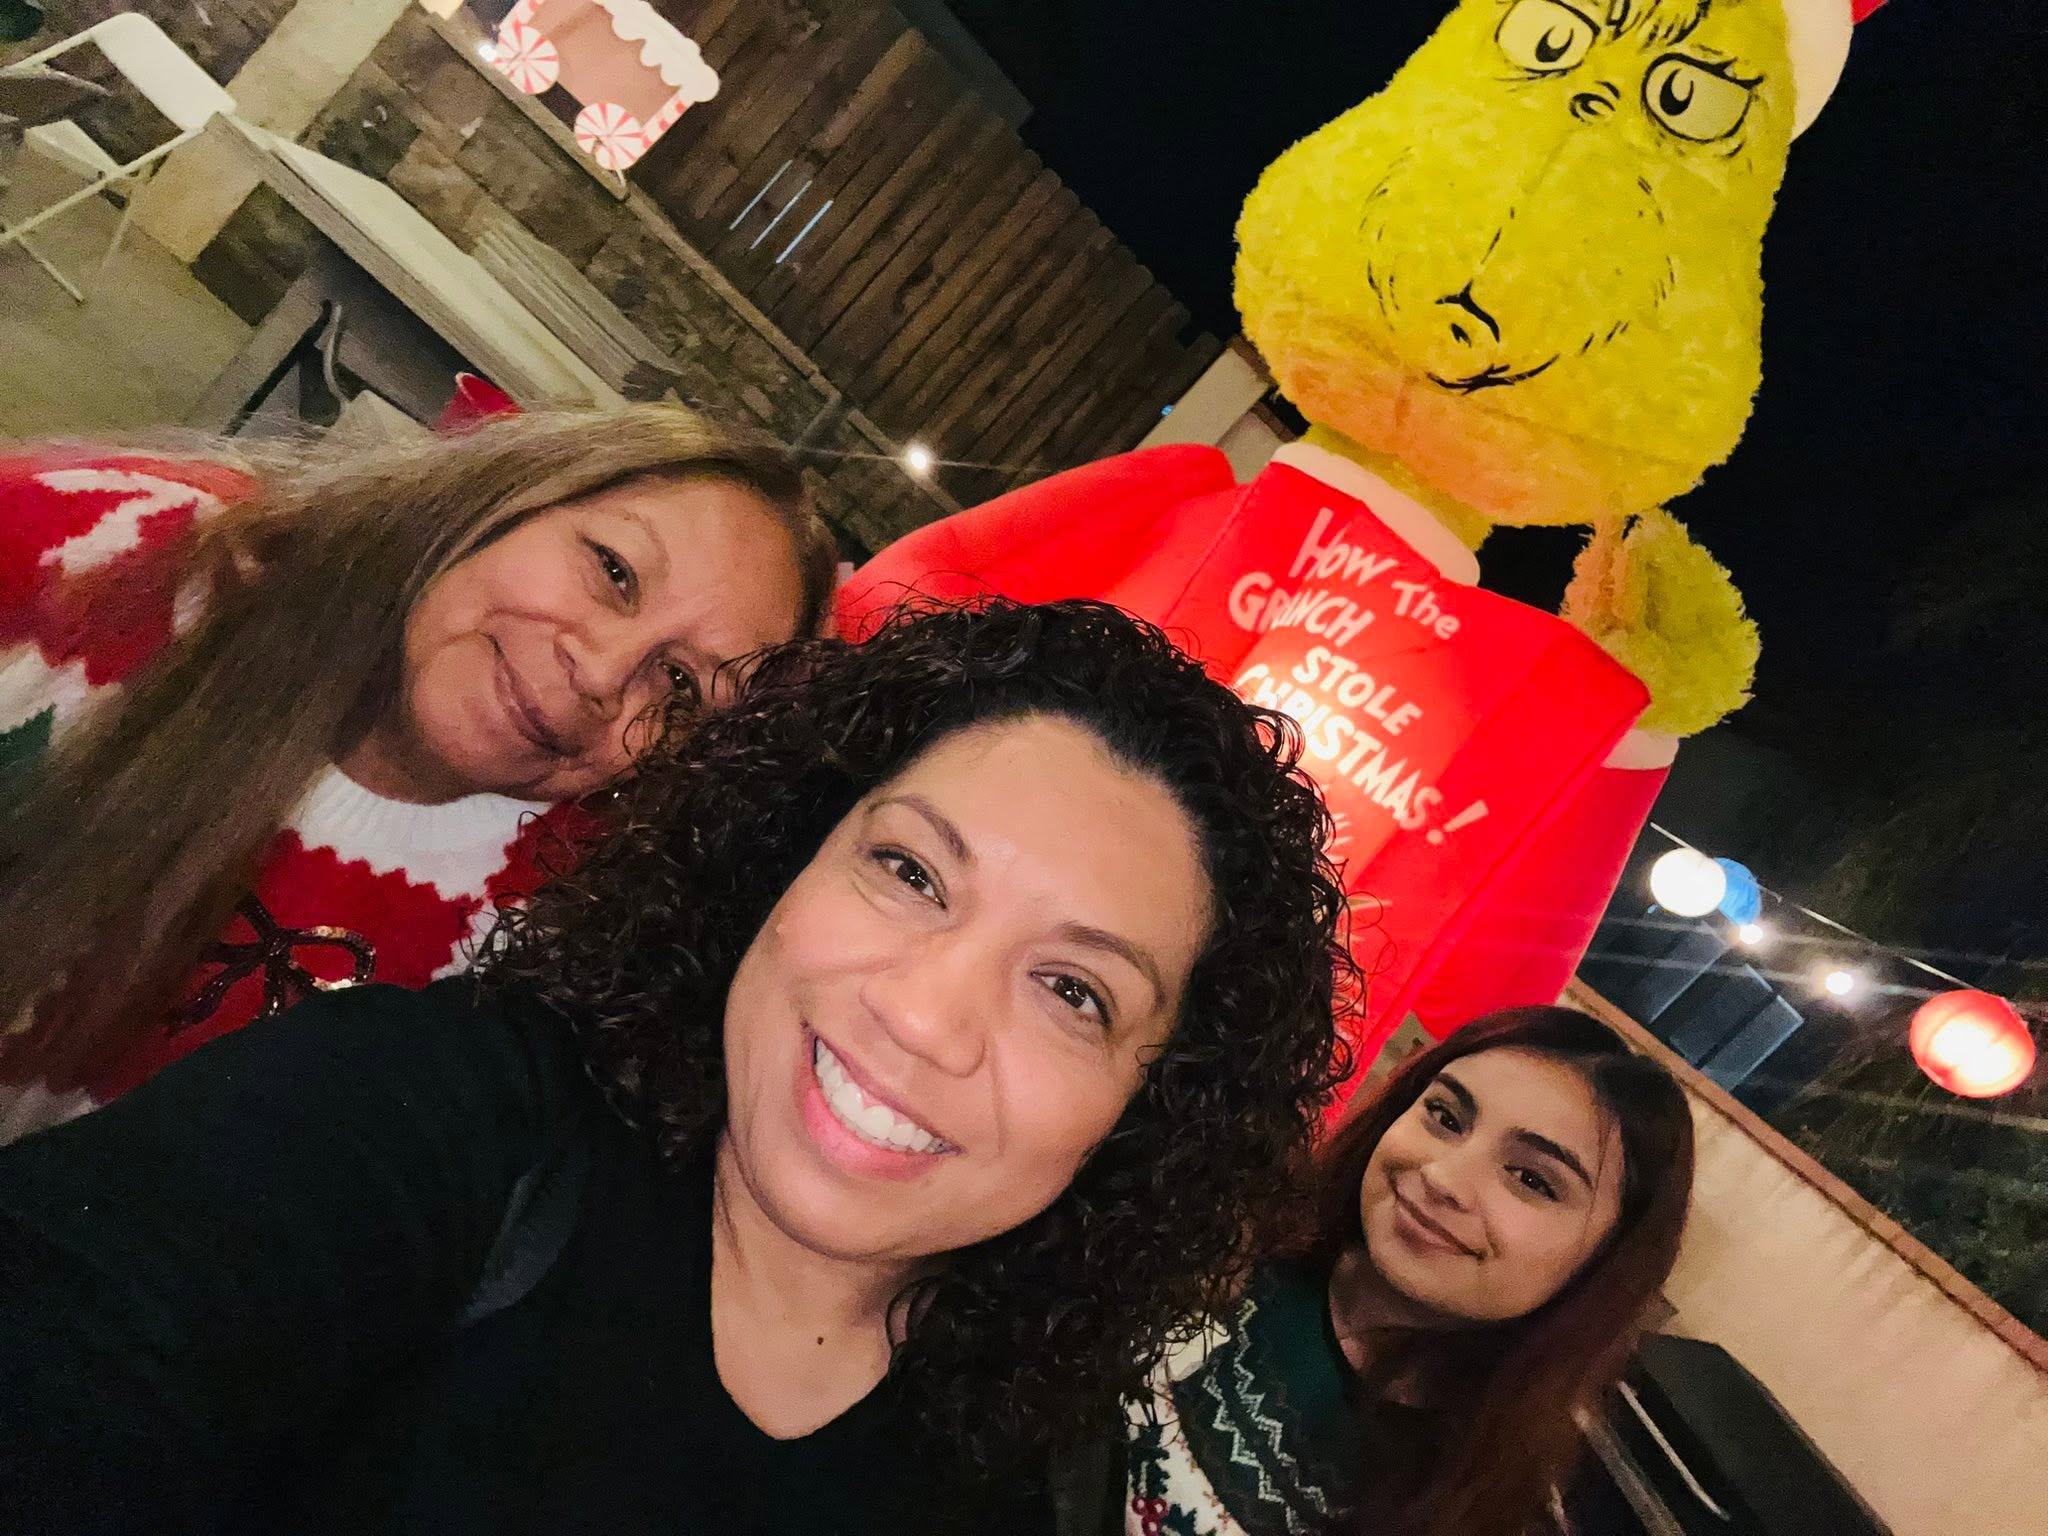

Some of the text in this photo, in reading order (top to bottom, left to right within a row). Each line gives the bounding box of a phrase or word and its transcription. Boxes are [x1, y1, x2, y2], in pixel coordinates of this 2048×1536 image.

[1229, 572, 1375, 648] GRINCH
[1289, 507, 1461, 640] How The
[1292, 646, 1421, 736] STOLE
